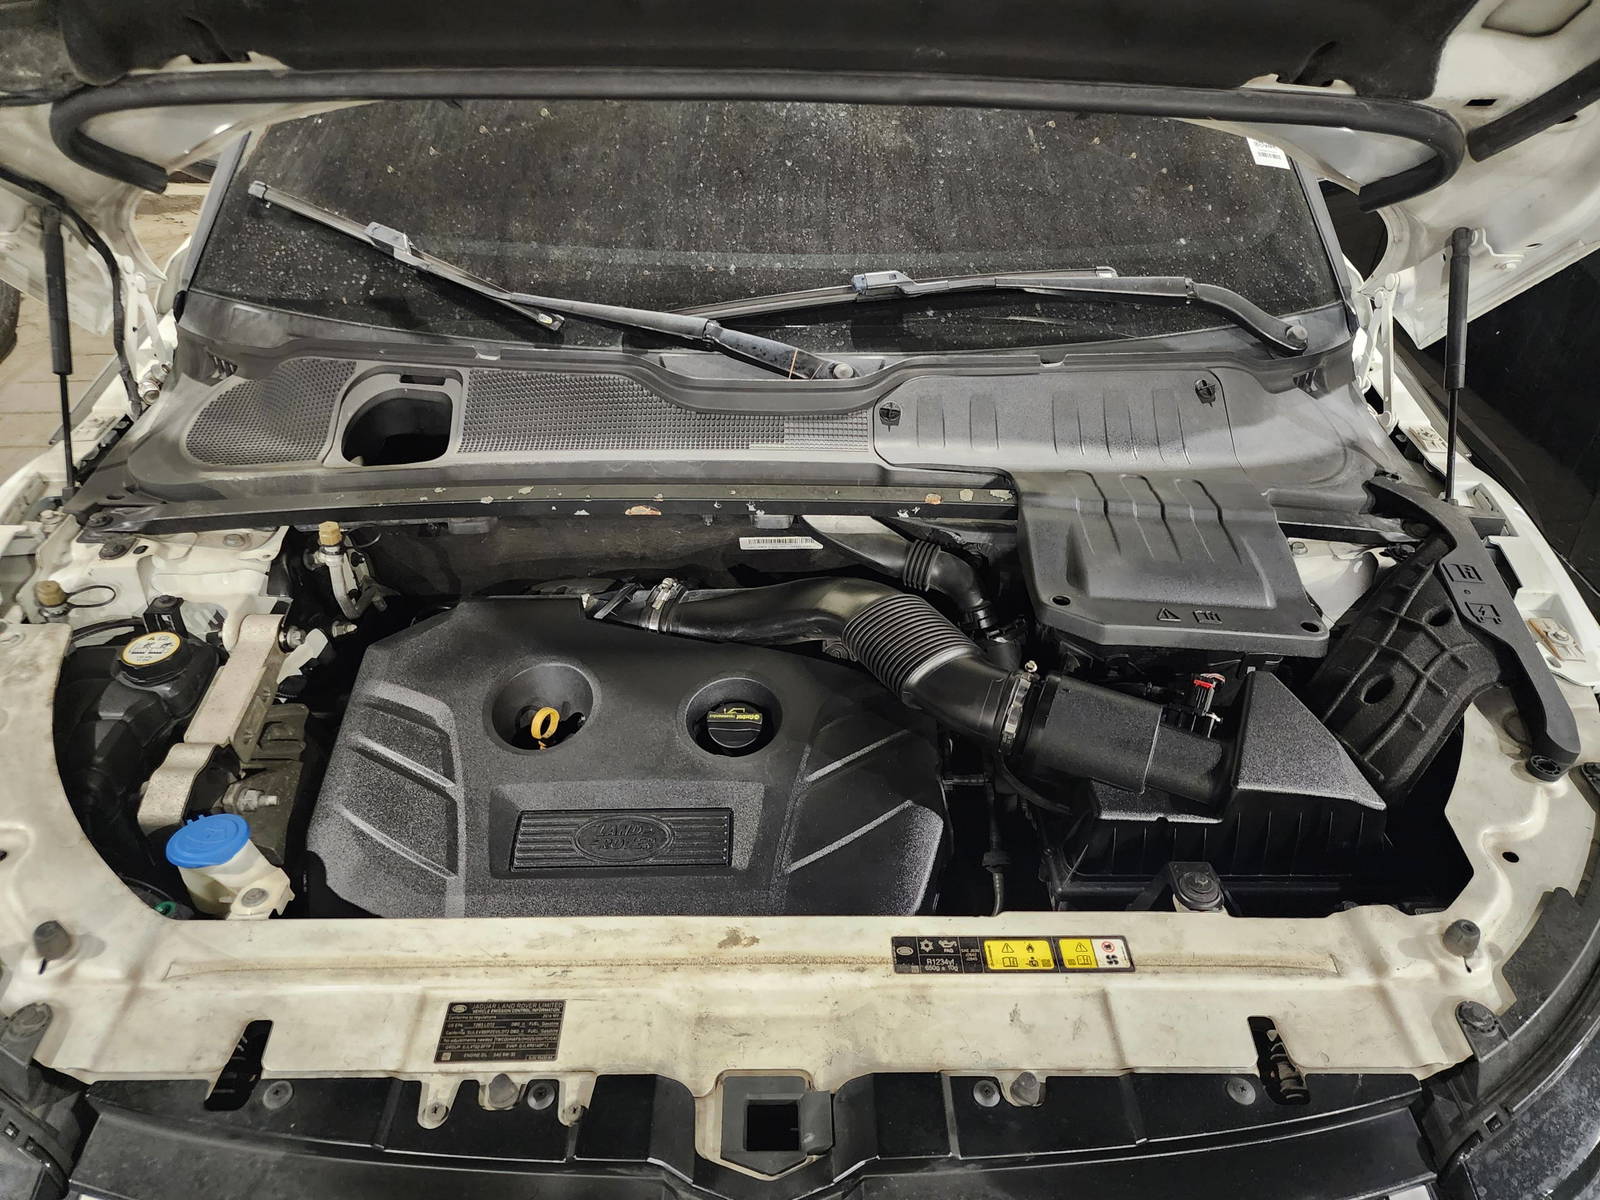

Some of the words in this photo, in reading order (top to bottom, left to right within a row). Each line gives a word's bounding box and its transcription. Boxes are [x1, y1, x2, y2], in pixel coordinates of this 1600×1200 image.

[599, 823, 644, 837] LAND
[600, 837, 656, 850] ROVER
[926, 958, 955, 966] R1234yf
